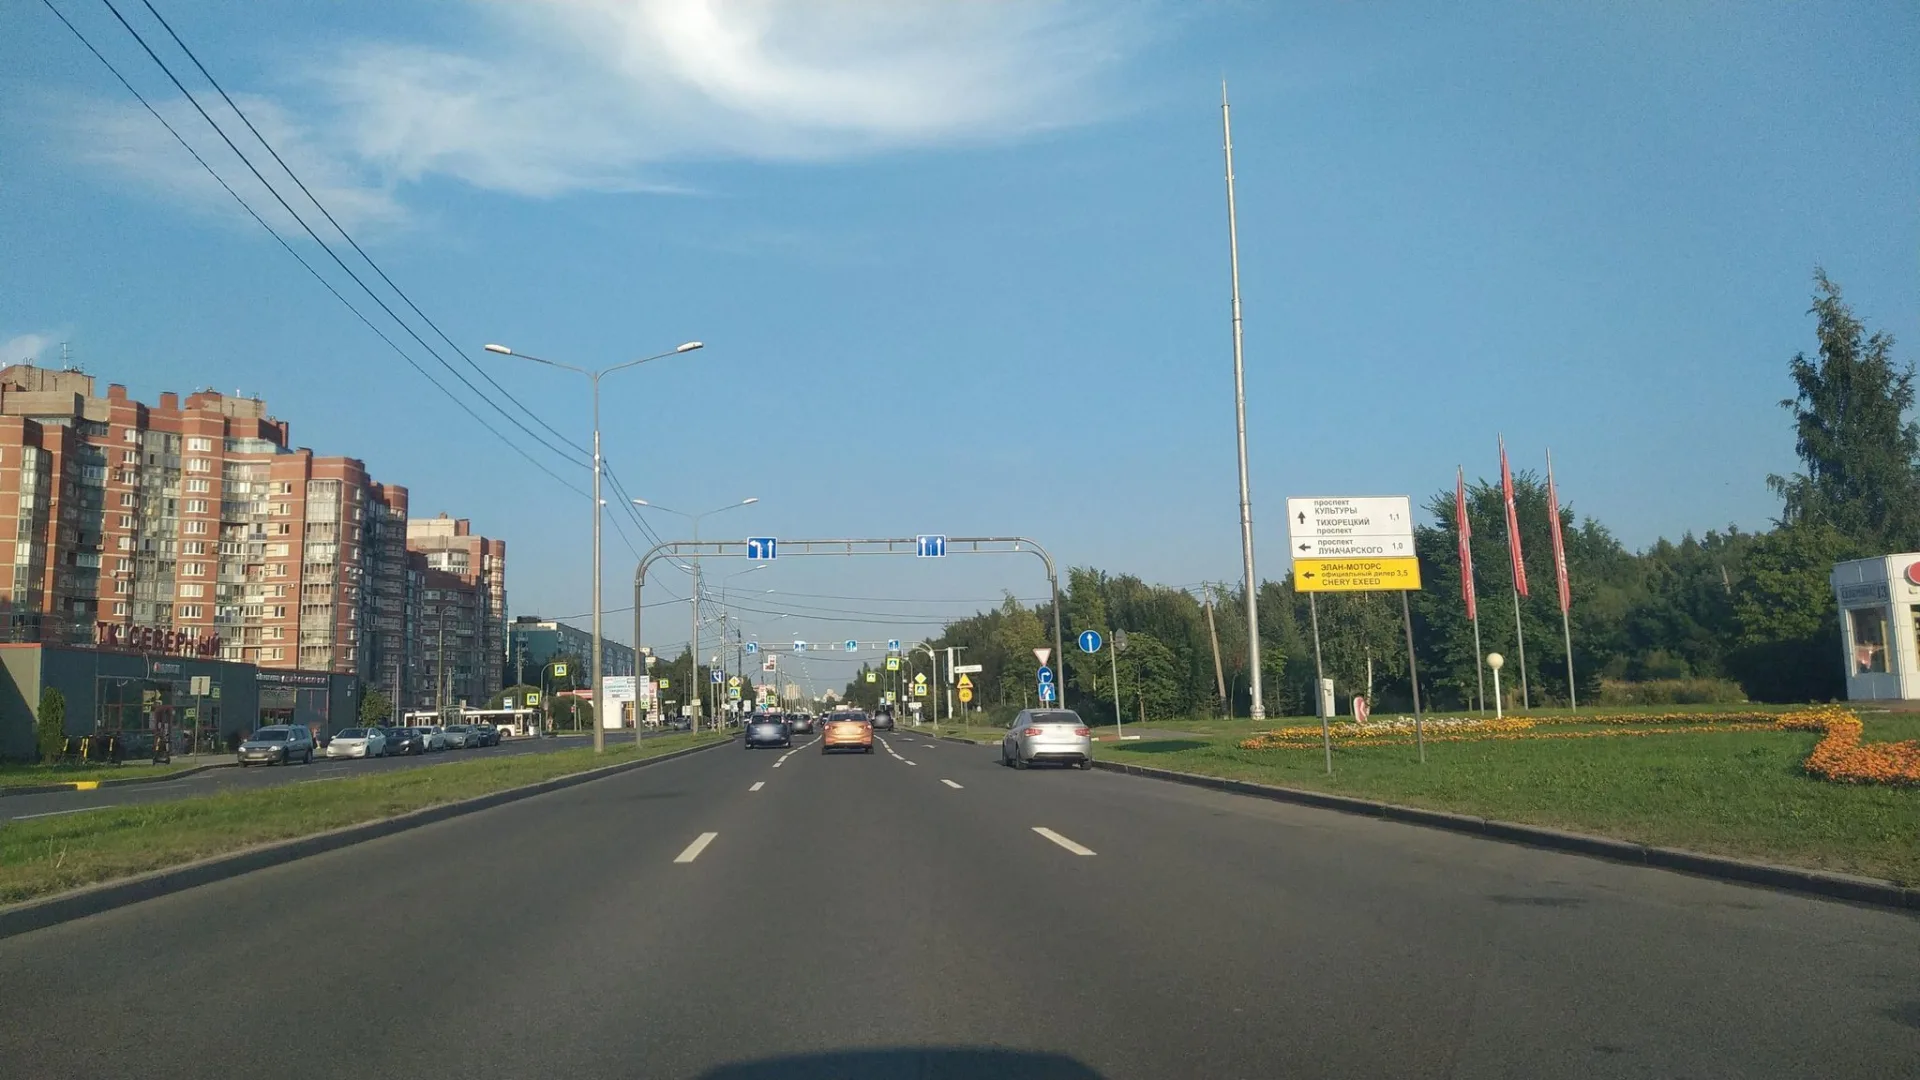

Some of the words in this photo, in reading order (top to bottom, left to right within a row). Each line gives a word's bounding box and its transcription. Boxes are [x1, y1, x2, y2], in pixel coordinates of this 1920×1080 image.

[1389, 513, 1400, 521] 1,1
[1316, 517, 1370, 526] ТИХОРЕЦКИЙ
[1318, 546, 1383, 554] ЛУНАЧАРСКОГО
[1392, 542, 1403, 550] 1,0
[1321, 563, 1381, 571] ЭЛАН-МОТОРС
[1322, 578, 1350, 586] CHERY
